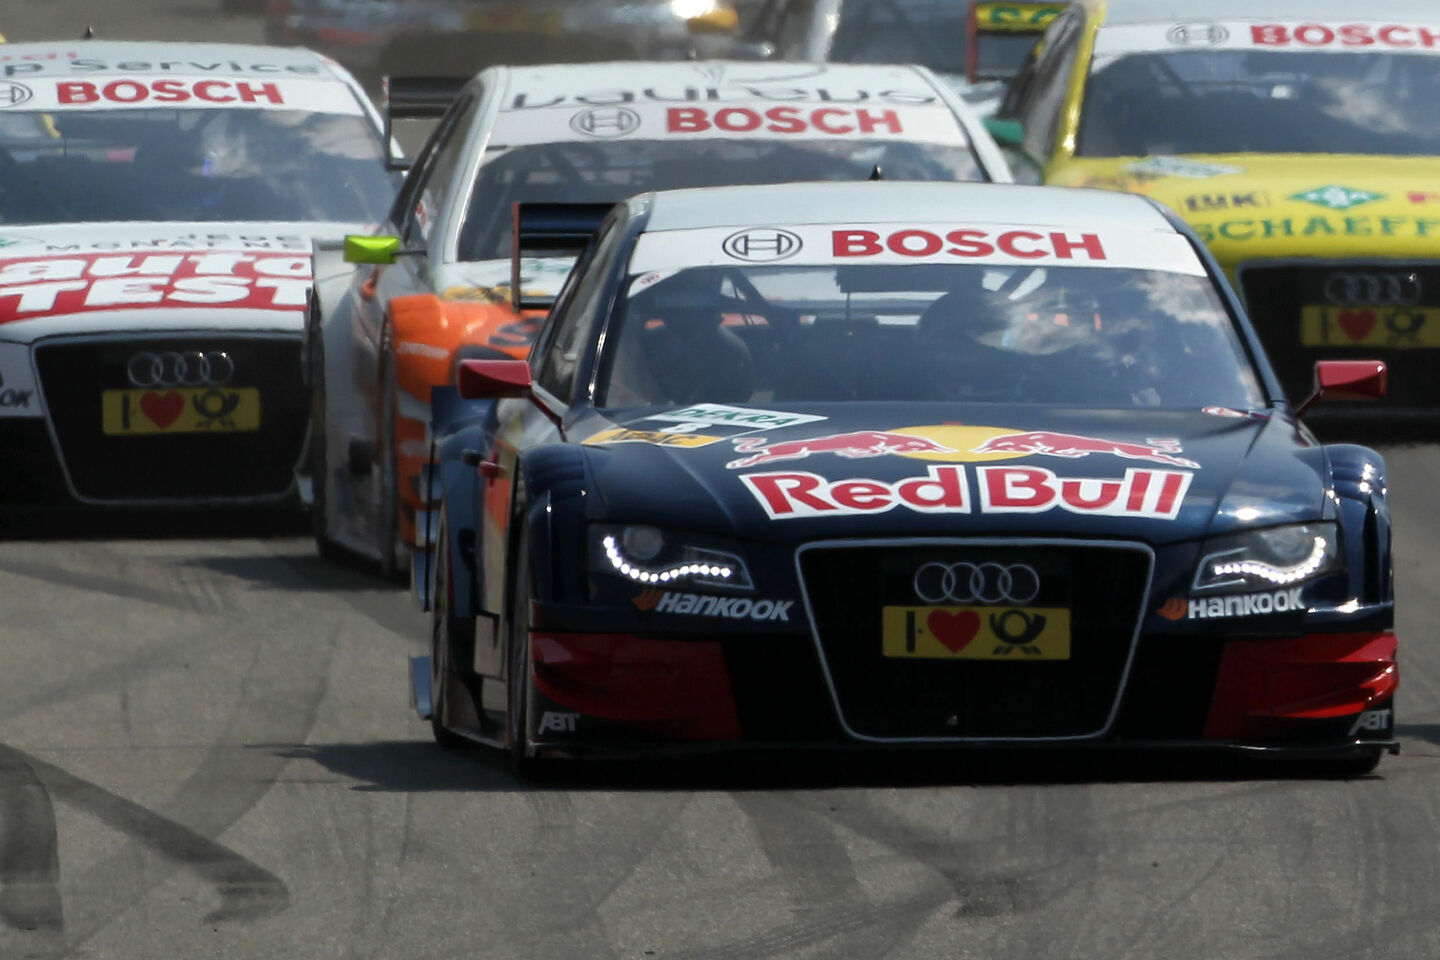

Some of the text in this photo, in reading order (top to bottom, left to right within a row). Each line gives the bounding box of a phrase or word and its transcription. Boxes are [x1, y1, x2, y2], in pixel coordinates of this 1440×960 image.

[57, 80, 284, 104] BOSCH
[667, 107, 902, 135] BOSCH
[832, 228, 1106, 260] BOSCH
[0, 252, 311, 285] auto
[0, 277, 311, 313] TEST
[669, 407, 799, 426] DEKRA
[747, 466, 1186, 516] Red Bull
[537, 711, 581, 736] ABT
[1347, 709, 1391, 737] ABT
